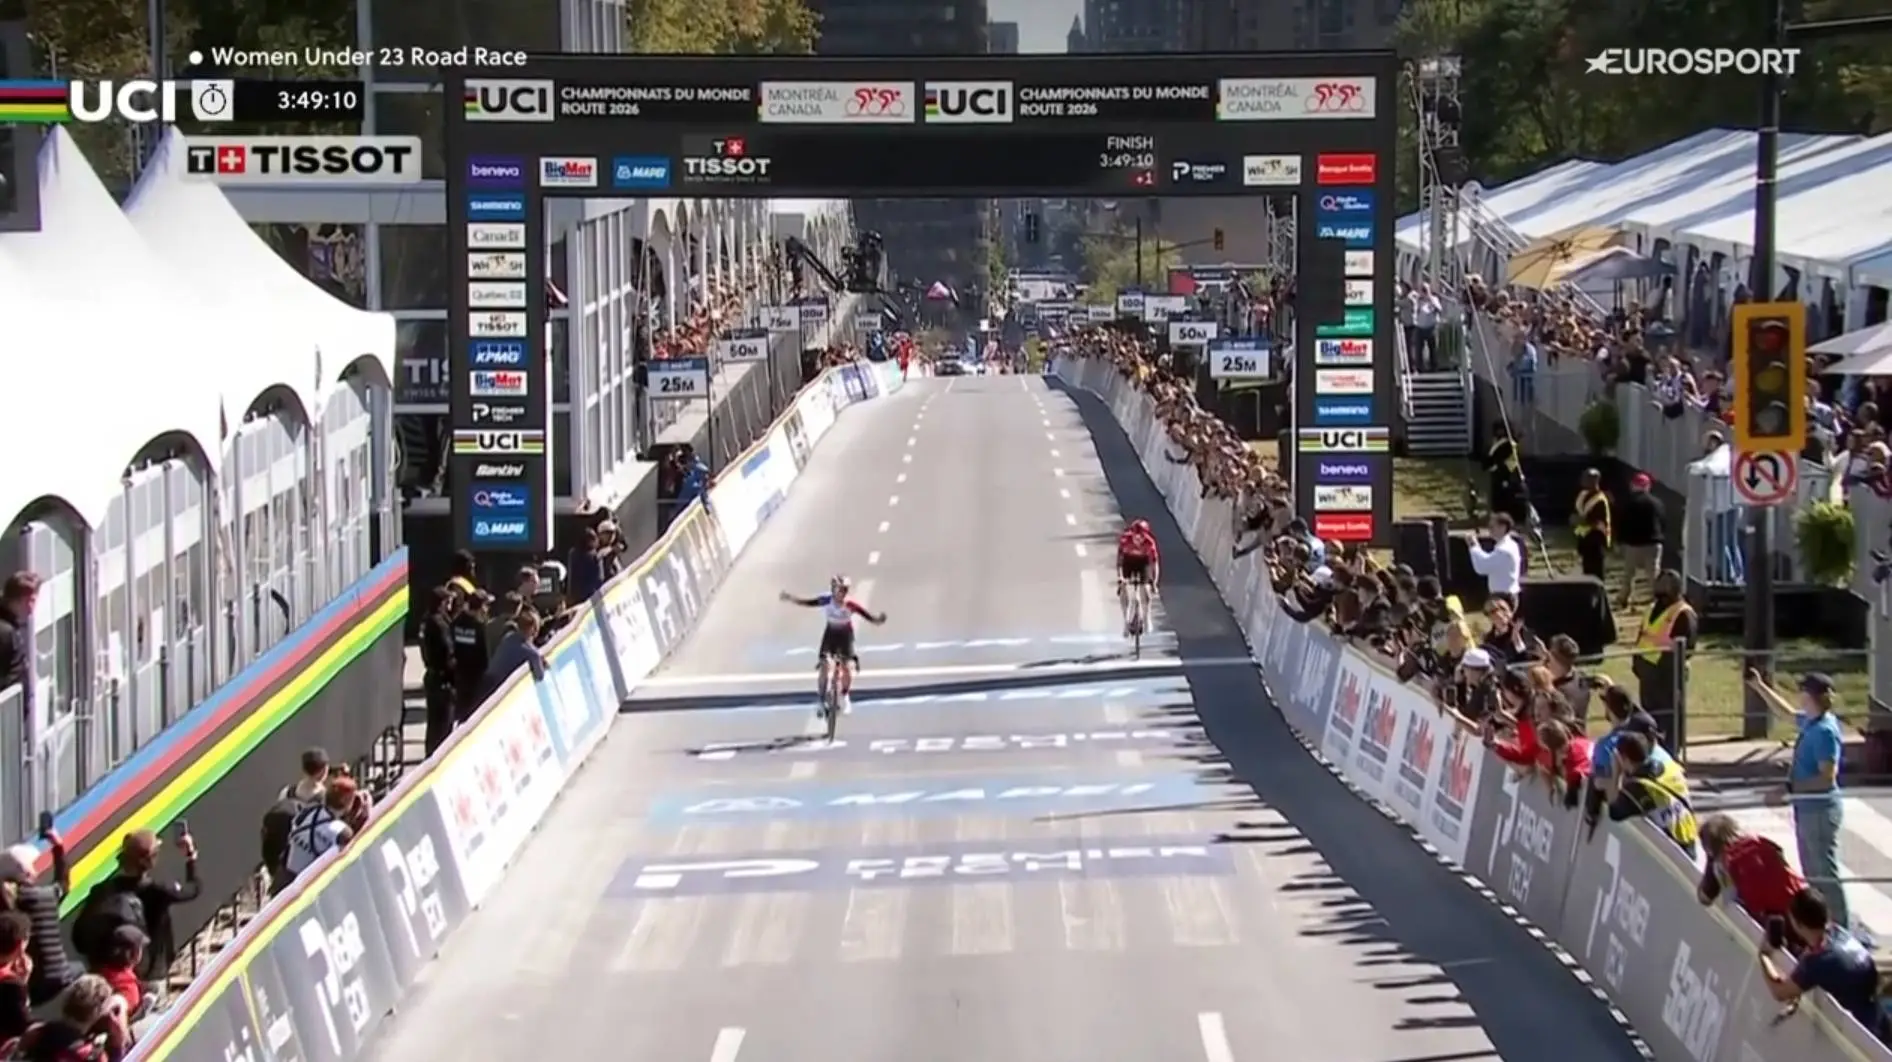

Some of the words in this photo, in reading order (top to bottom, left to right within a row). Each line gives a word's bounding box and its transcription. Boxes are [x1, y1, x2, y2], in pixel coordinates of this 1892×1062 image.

[561, 87, 671, 100] CHAMPIONNATS
[675, 87, 695, 100] DU
[698, 88, 750, 100] MONDE
[768, 86, 839, 101] MONTRÉAL
[1020, 87, 1130, 100] CHAMPIONNATS
[1133, 86, 1153, 99] DU
[1156, 86, 1209, 99] MONDE
[1226, 83, 1299, 98] MONTRÉAL
[481, 87, 546, 113] UCI
[940, 89, 1006, 115] UCI
[561, 103, 606, 115] ROUTE
[609, 103, 640, 115] 2026
[768, 103, 823, 116] CANADA
[1020, 103, 1064, 115] ROUTE
[1067, 103, 1098, 115] 2026
[1226, 101, 1282, 113] CANADA
[1107, 136, 1154, 149] FINISH
[684, 158, 771, 174] TISSOT
[1100, 154, 1154, 167] 3:49:10
[471, 164, 519, 177] beneva
[543, 161, 593, 178] BigMat
[631, 167, 667, 178] MAPEI
[1136, 172, 1154, 184] +1
[477, 322, 519, 332] TISSOT
[1179, 327, 1208, 340] 50M
[729, 345, 758, 357] 50M
[1320, 341, 1367, 358] BigMat
[475, 351, 520, 364] KPMG
[1222, 356, 1257, 372] 25M
[475, 372, 523, 389] BigMat
[660, 375, 695, 393] 25M
[478, 433, 519, 450] UCI
[1322, 431, 1363, 448] UCI
[1320, 462, 1369, 475] beneva
[1514, 801, 1554, 864] PREMIER
[1508, 851, 1534, 904] TECH
